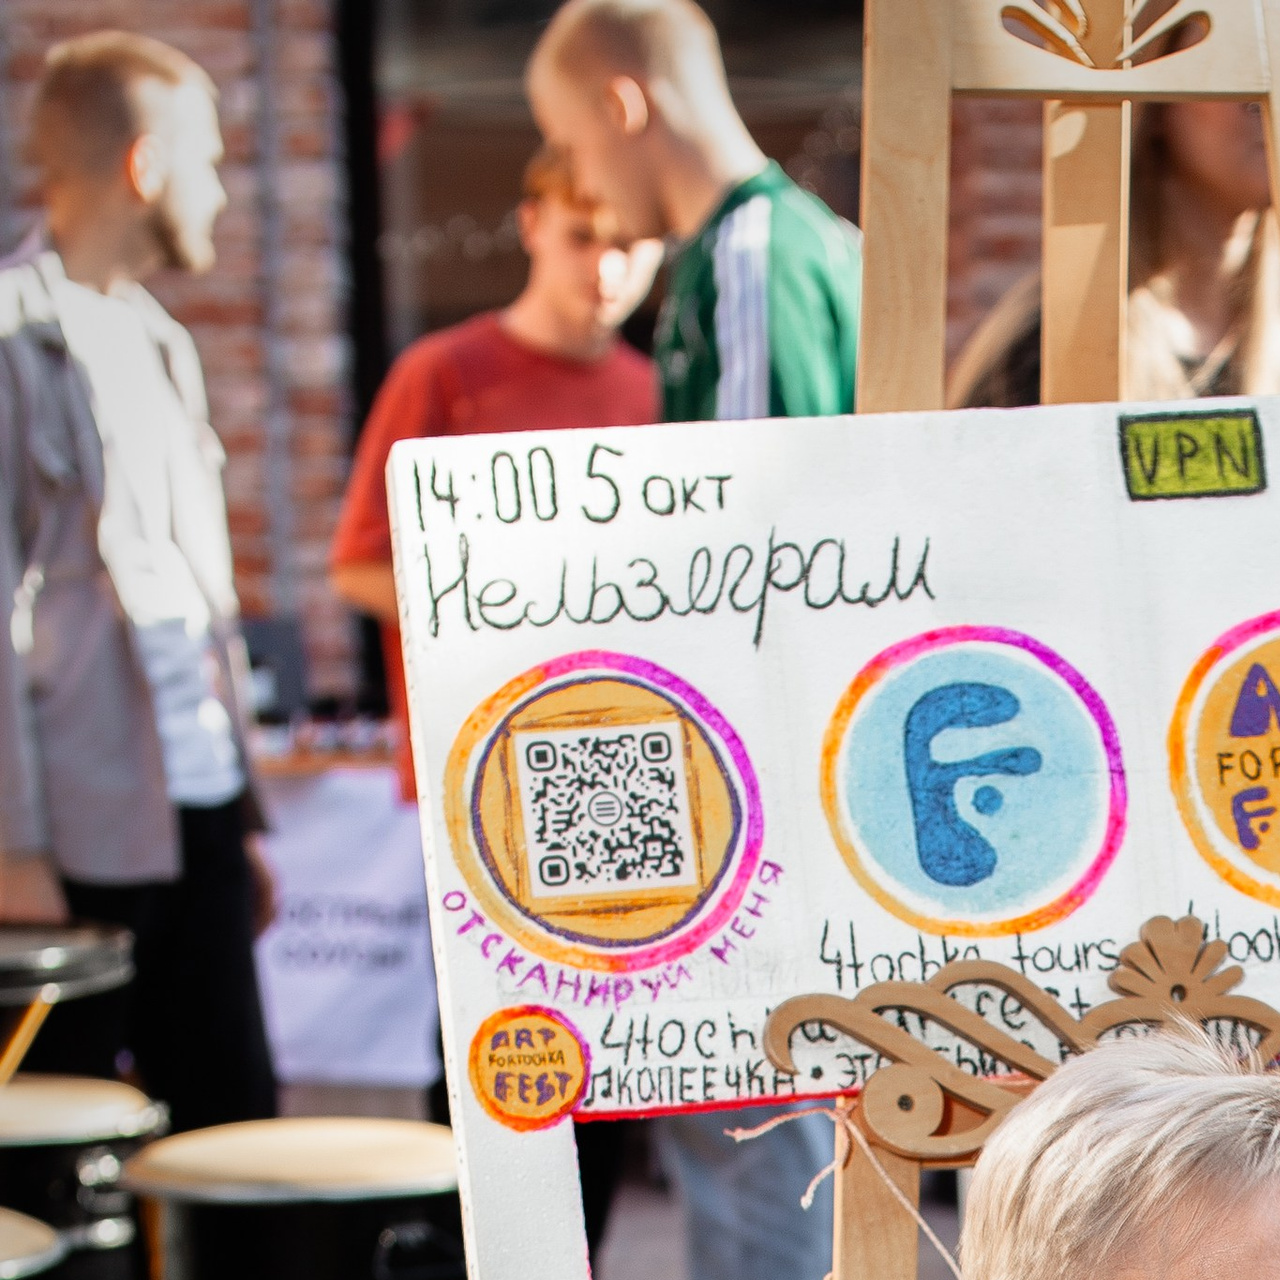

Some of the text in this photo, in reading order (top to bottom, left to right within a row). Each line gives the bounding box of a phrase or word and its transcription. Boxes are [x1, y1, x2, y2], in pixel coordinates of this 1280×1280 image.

[1127, 437, 1255, 487] VPN
[413, 445, 560, 533] 14:00
[582, 443, 625, 525] 5
[710, 859, 786, 965] МЕНЯ
[490, 1026, 557, 1051] ART
[493, 1070, 574, 1107] FEST
